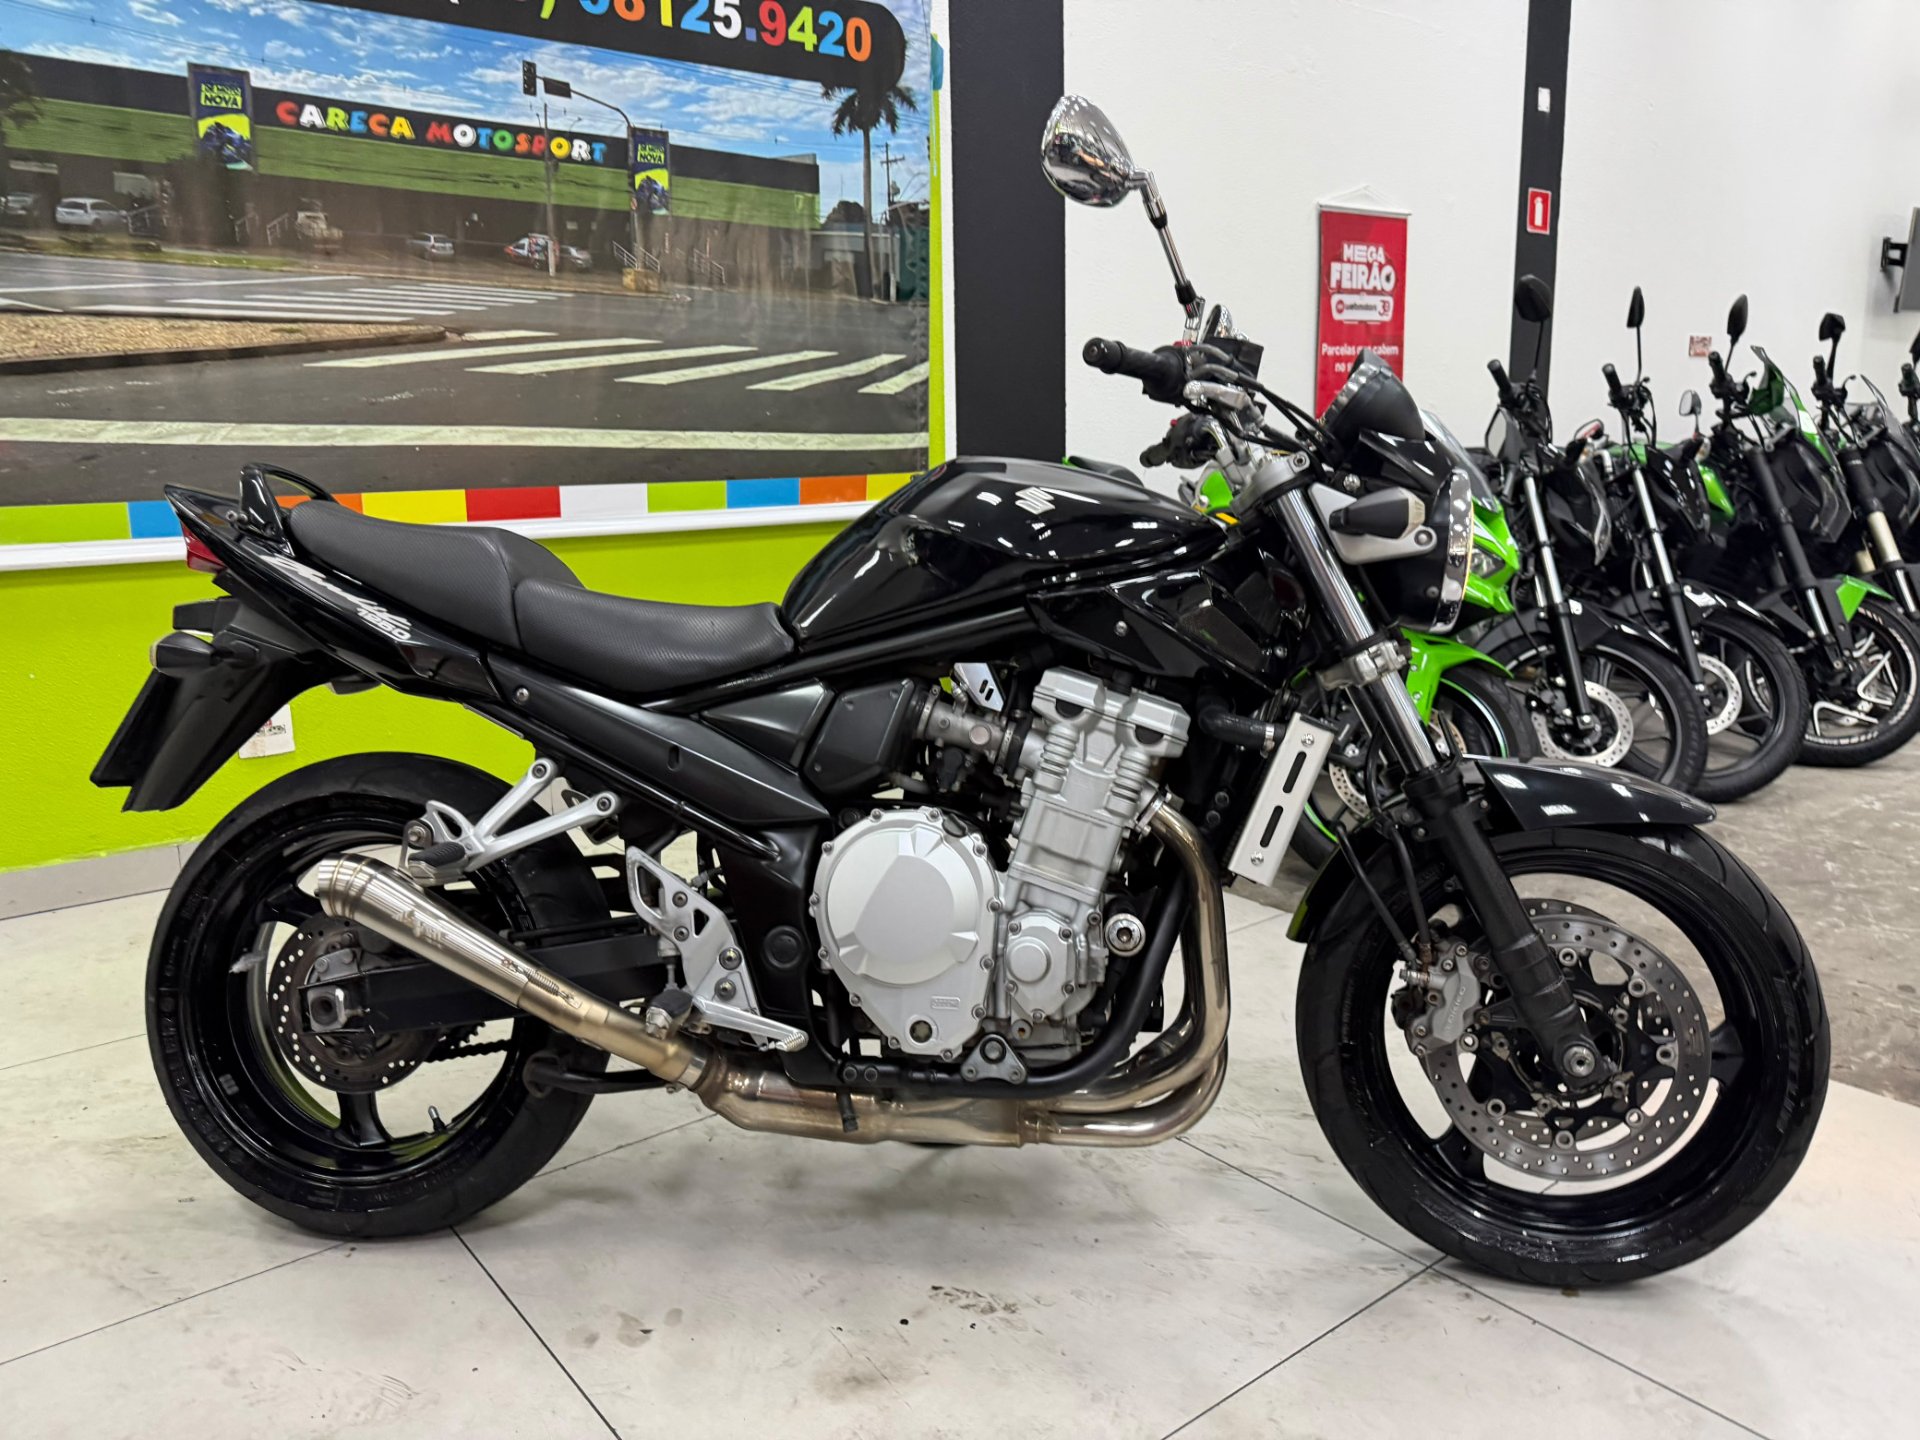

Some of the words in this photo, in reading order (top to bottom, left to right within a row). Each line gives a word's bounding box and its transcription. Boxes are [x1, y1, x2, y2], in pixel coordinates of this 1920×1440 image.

[204, 94, 239, 107] NOVA
[276, 101, 416, 139] CARECA
[426, 121, 608, 163] MOTOSPORT
[1343, 243, 1386, 264] MEGA
[1330, 261, 1396, 292] FEIRÃO
[1321, 343, 1356, 356] Parcelas
[355, 606, 412, 641] 1250
